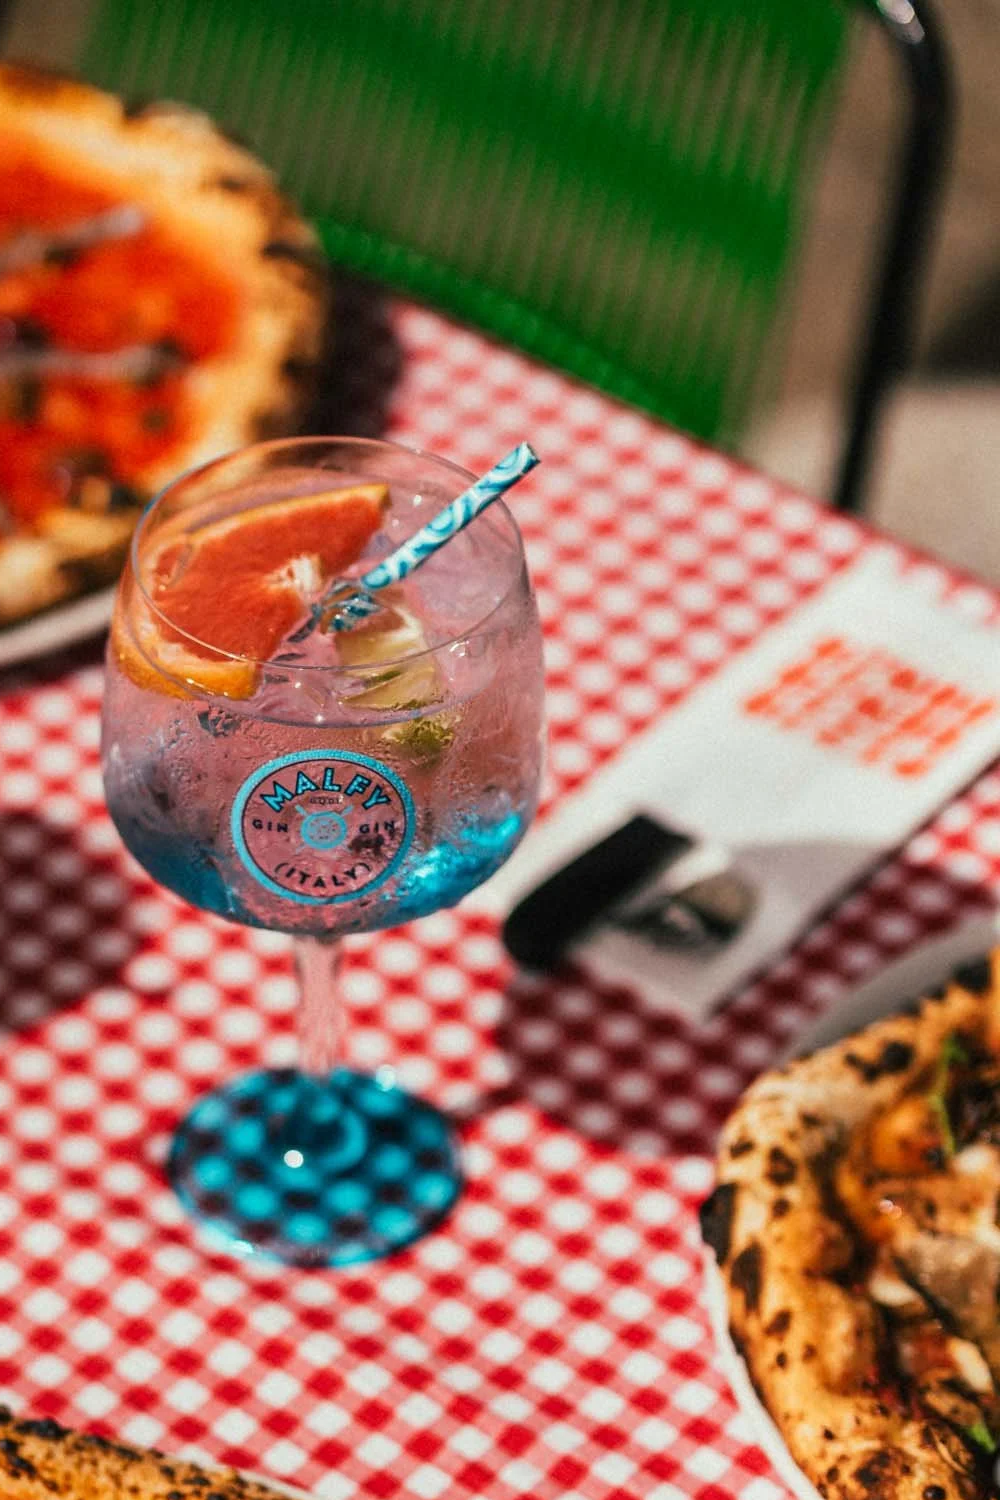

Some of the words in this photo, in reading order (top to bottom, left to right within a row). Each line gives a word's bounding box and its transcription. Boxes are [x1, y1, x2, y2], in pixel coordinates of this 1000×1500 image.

[260, 767, 391, 812] MALFY
[252, 819, 289, 833] GIN
[358, 820, 395, 834] GIN
[274, 862, 372, 888] (ITALY)
